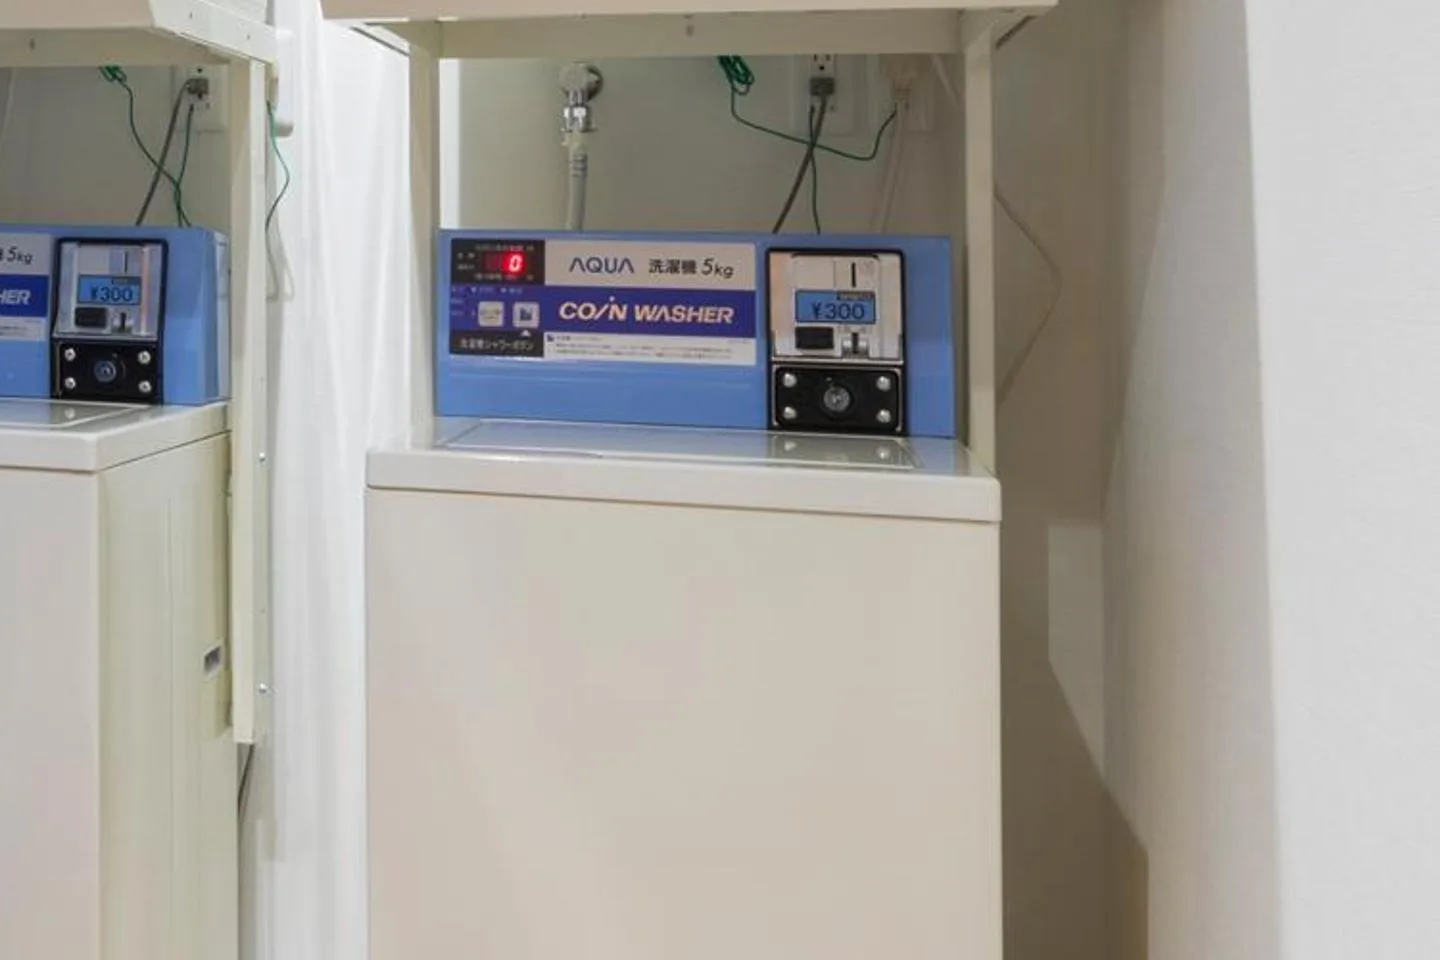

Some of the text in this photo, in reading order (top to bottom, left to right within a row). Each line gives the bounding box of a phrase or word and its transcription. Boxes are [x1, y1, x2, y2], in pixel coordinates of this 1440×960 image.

[6, 246, 34, 266] 5kg
[508, 254, 523, 273] 0
[569, 256, 735, 279] AQUA 洗濯機 5kg
[634, 303, 735, 324] WASHER
[811, 302, 866, 320] ¥300
